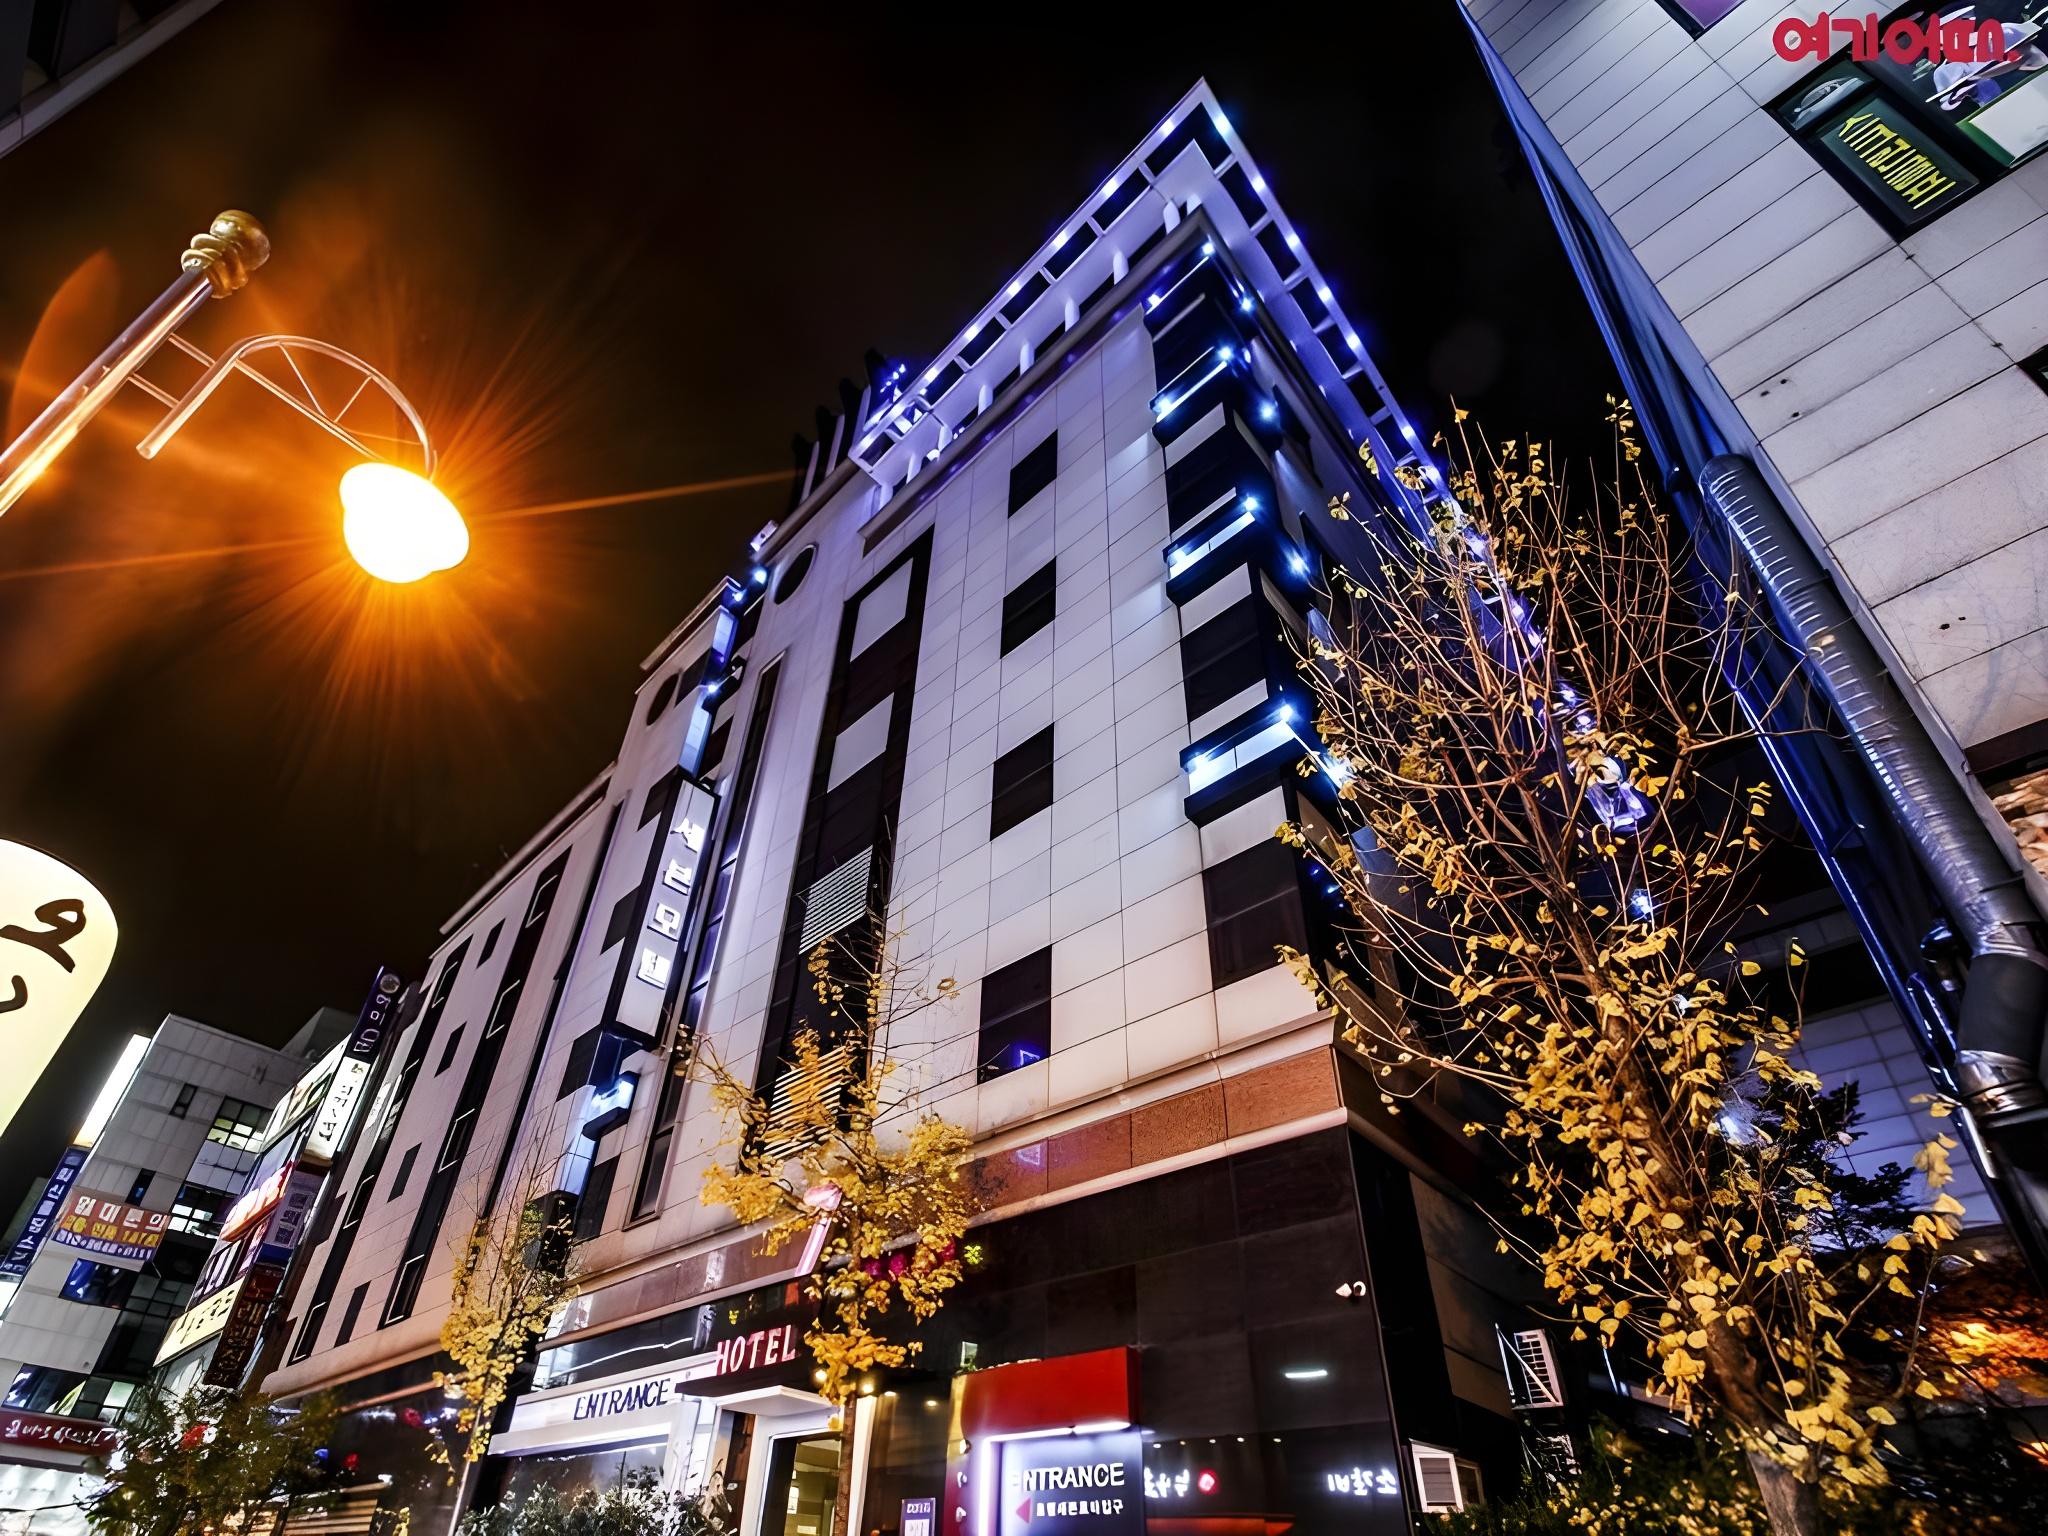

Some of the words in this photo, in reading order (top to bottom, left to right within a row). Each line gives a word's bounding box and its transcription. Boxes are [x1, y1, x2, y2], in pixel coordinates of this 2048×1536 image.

[716, 1324, 796, 1375] HOTEL
[573, 1378, 671, 1420] ENTRANCE
[1012, 1463, 1125, 1492] NTRANCE
